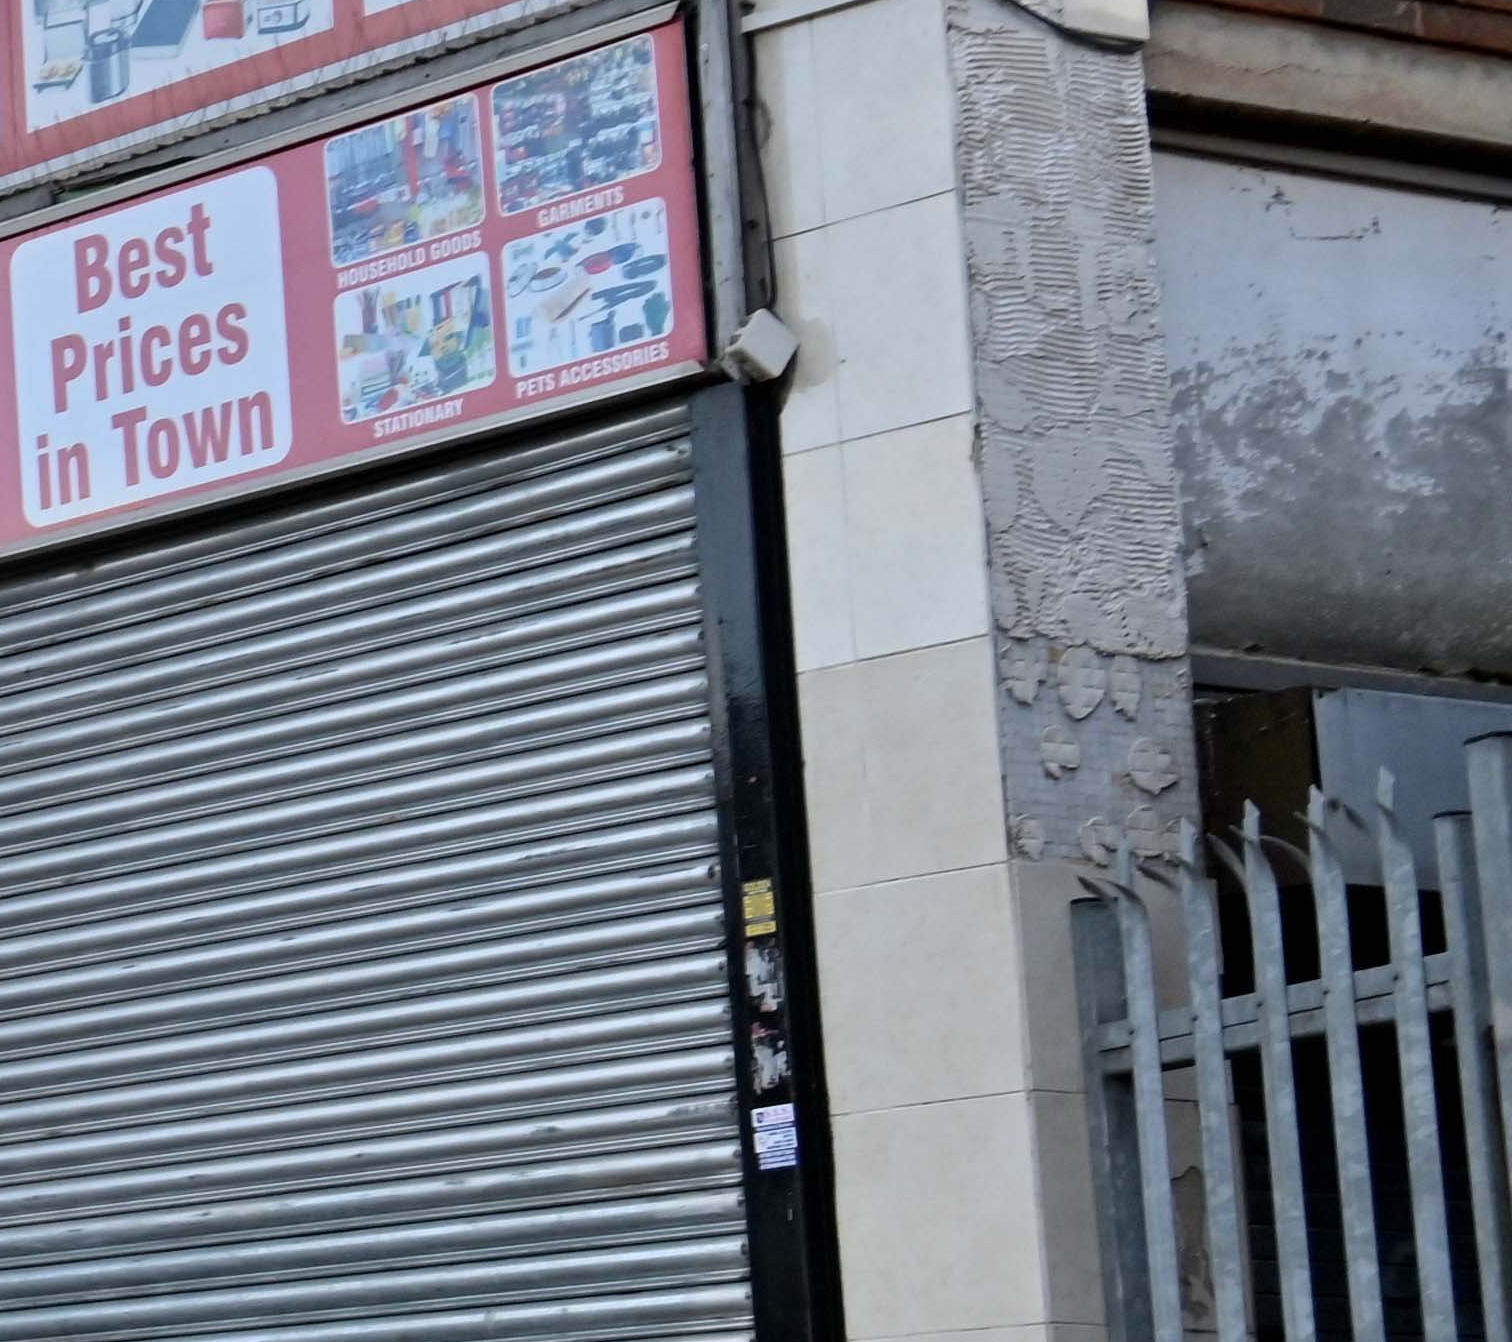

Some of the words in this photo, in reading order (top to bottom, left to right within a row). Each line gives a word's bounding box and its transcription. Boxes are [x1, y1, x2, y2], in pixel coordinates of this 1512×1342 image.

[536, 185, 625, 228] GARMENTS
[73, 202, 214, 314] Best
[337, 245, 426, 289] HOUSEHOLD
[430, 229, 483, 260] GOODS
[51, 302, 250, 415] Prices
[516, 375, 556, 400] PETS
[560, 341, 671, 388] ACCESSORIES
[373, 397, 464, 438] STATIONARY
[35, 433, 91, 511] in
[112, 389, 275, 488] Town
